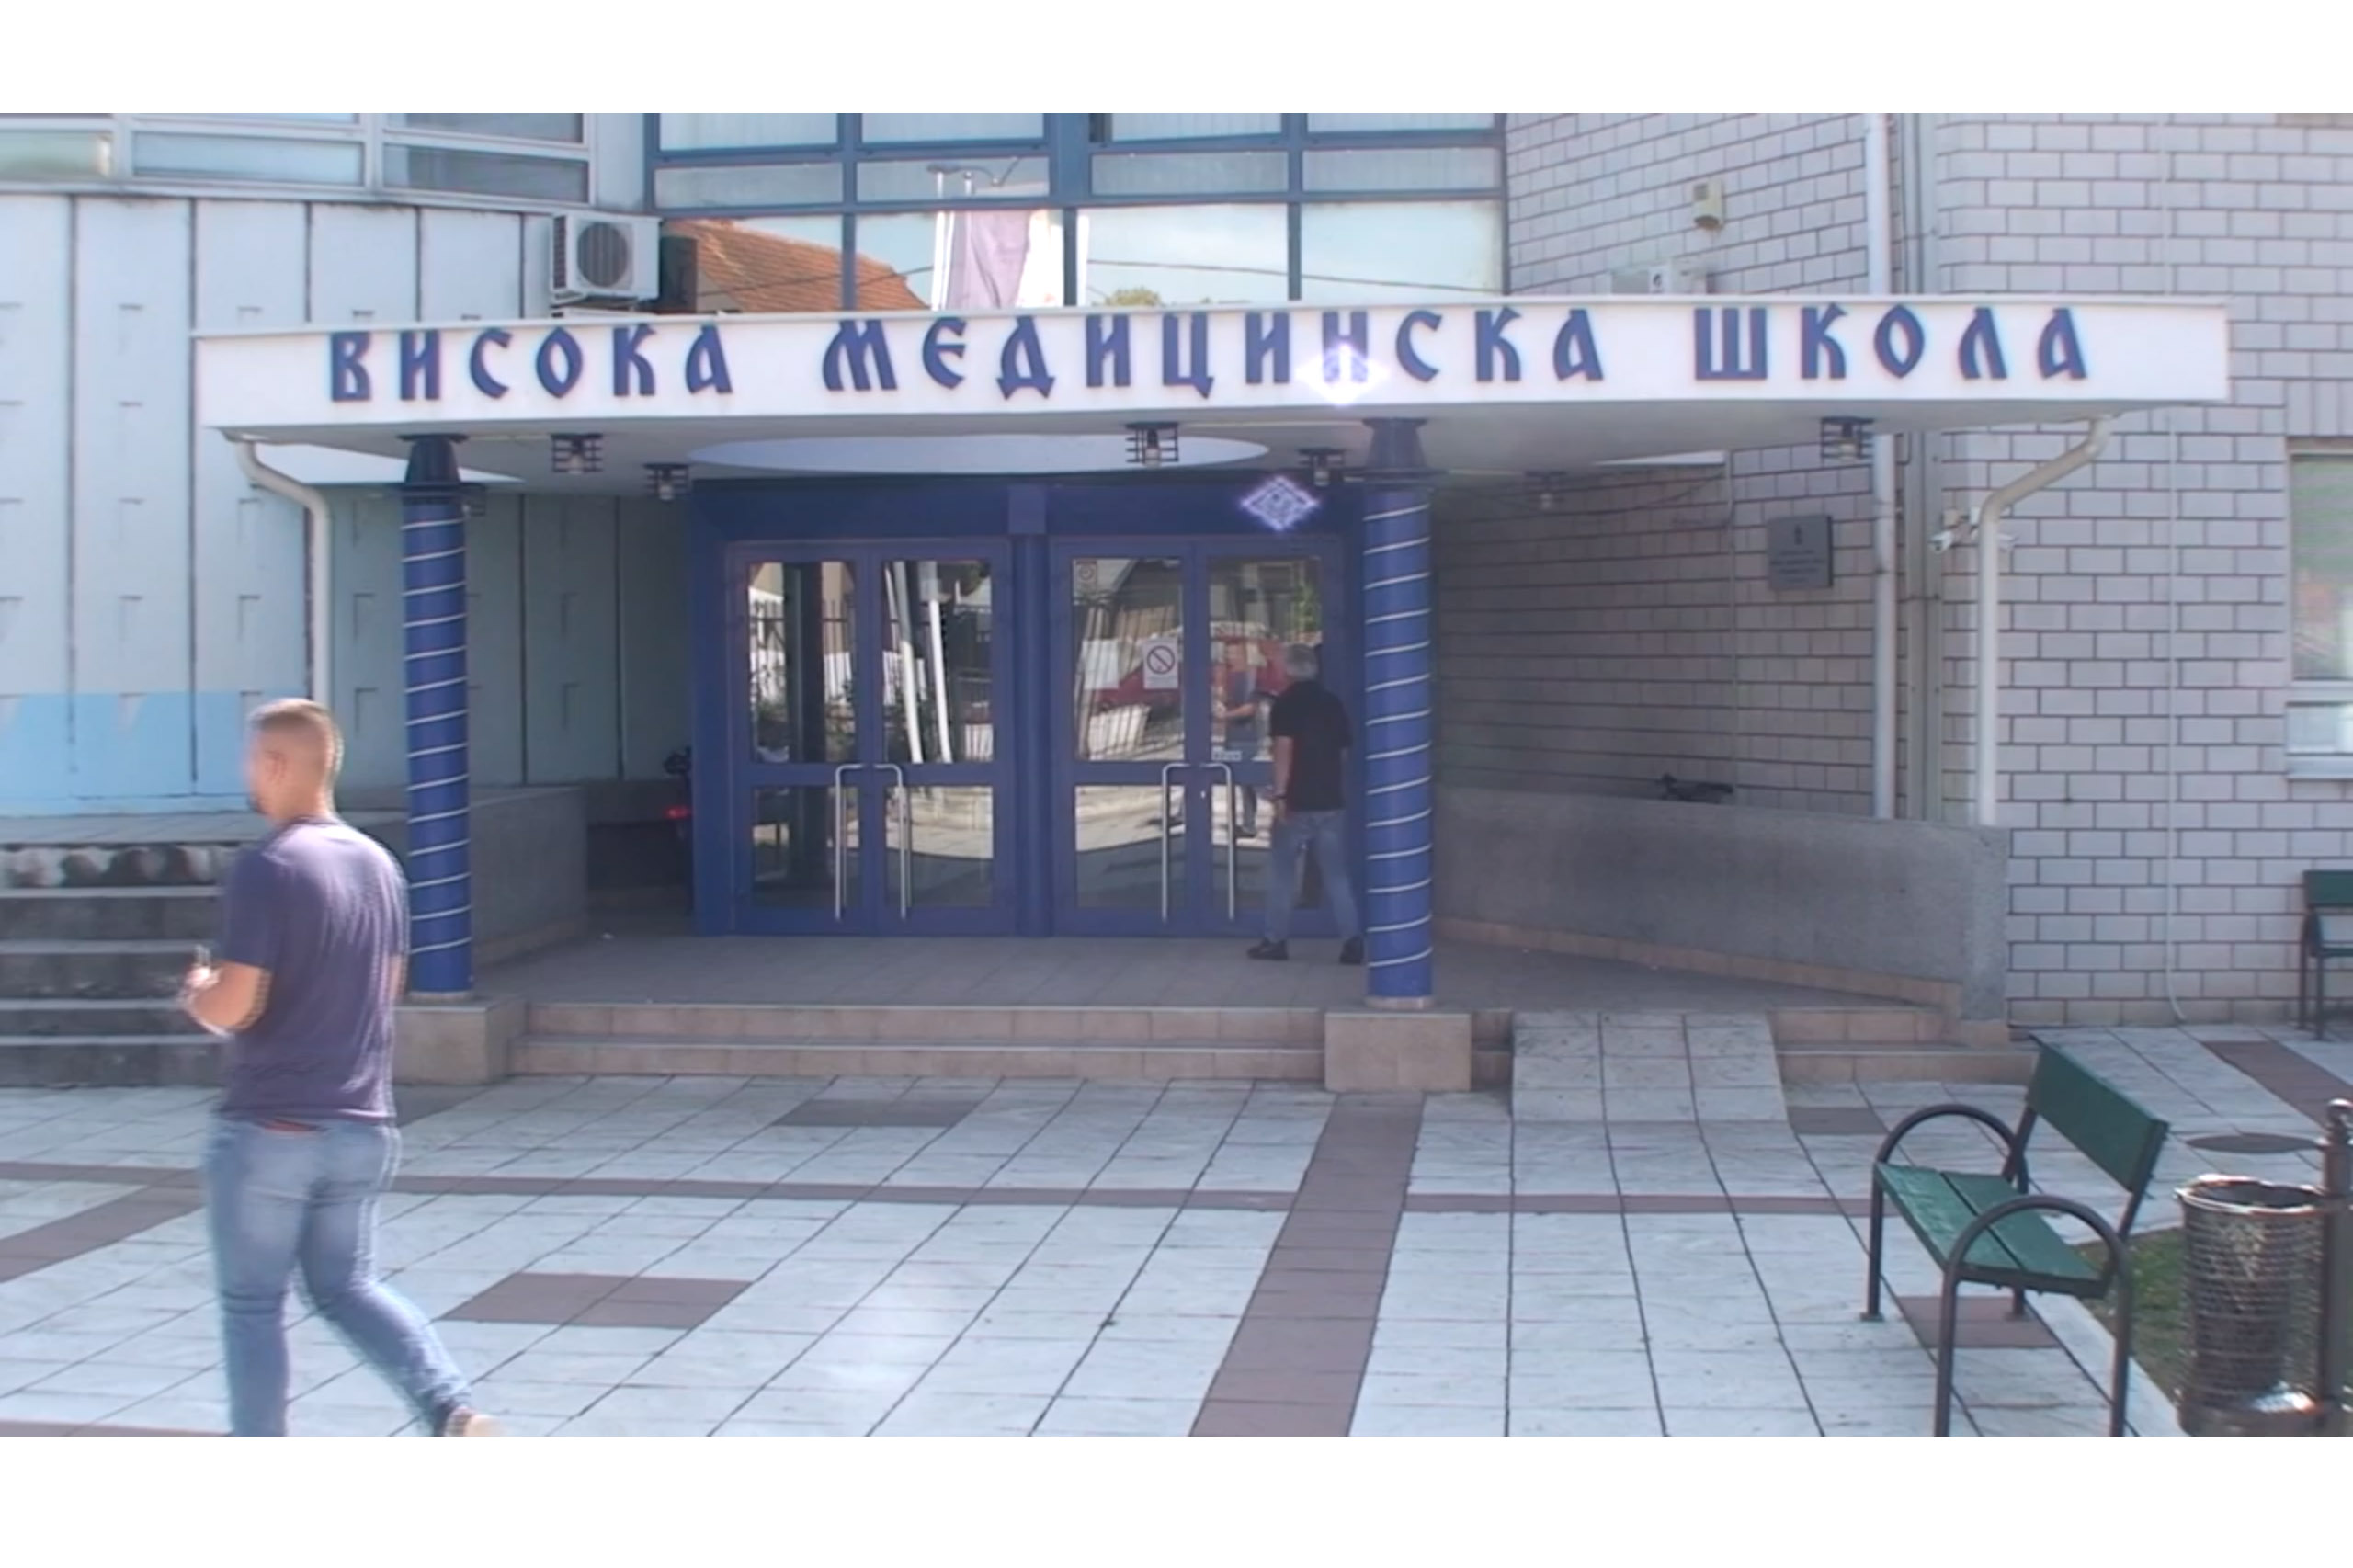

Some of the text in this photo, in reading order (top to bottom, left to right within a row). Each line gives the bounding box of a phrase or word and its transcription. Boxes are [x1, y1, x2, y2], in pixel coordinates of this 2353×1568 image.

[330, 303, 2088, 403] ВИСОКА МЕДИЦИНСКА ШКОЛА
